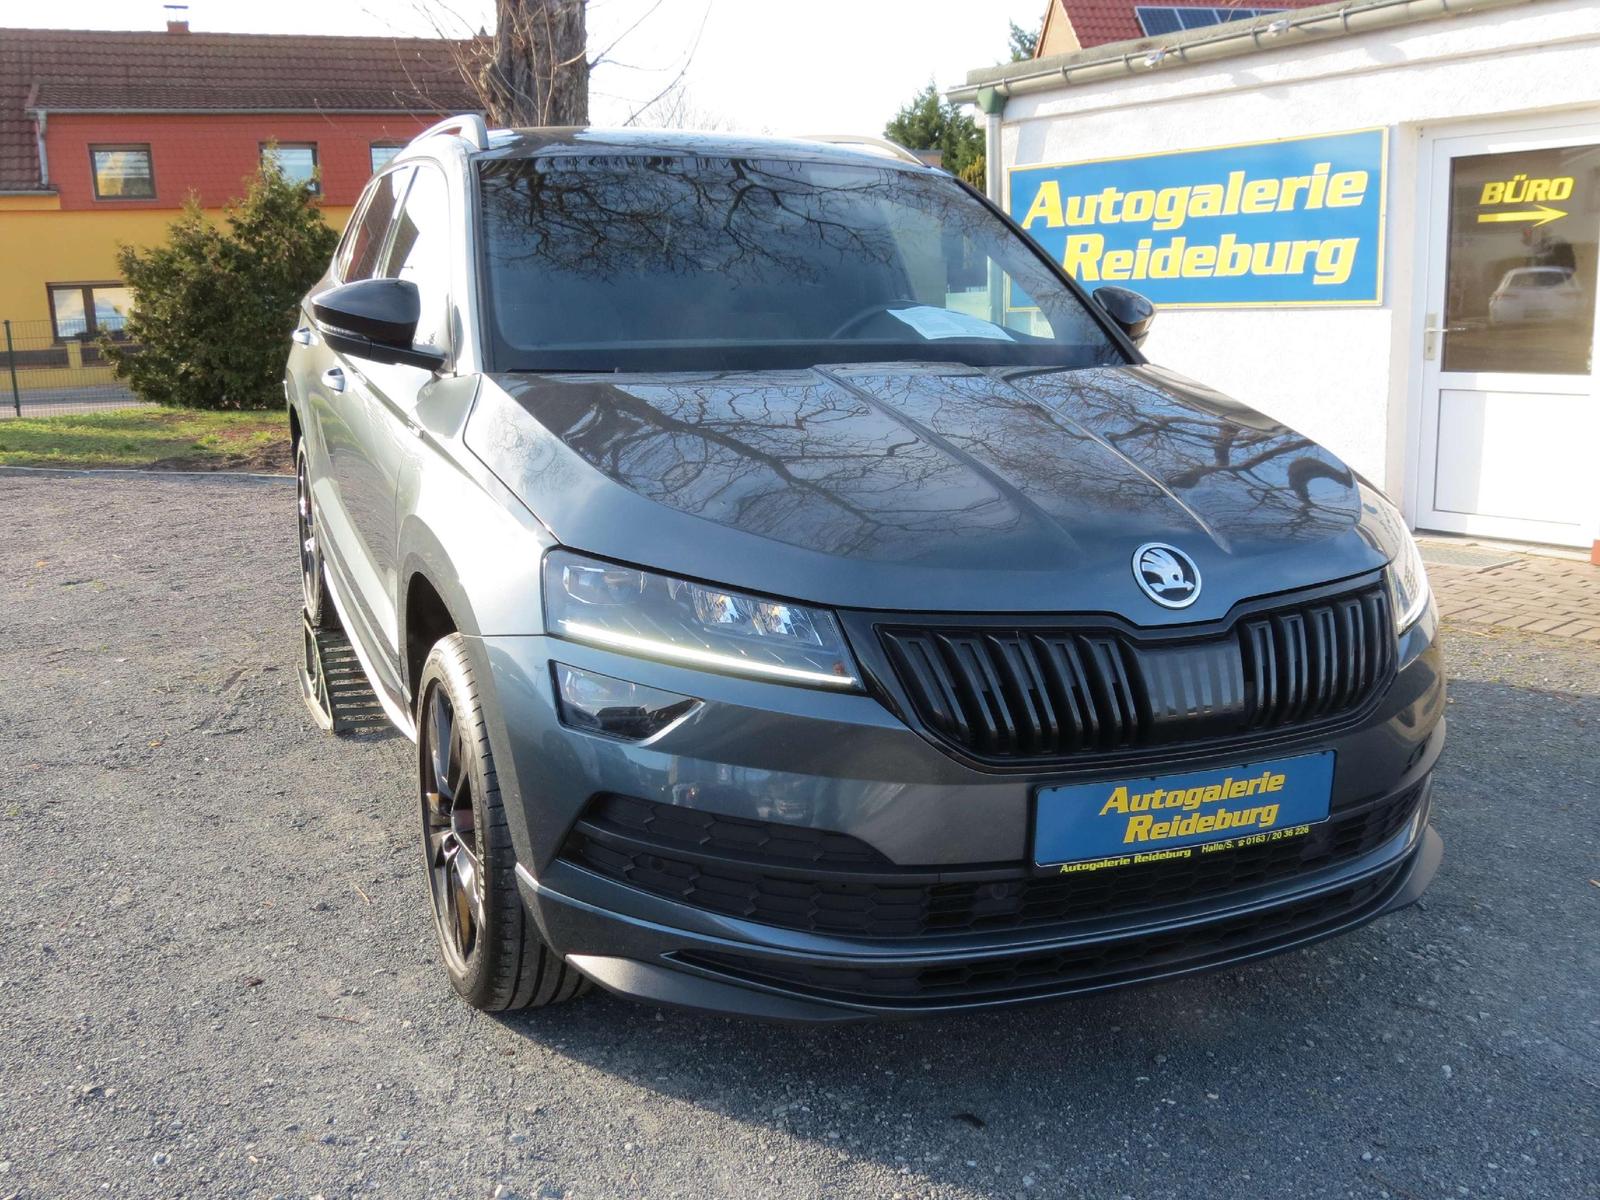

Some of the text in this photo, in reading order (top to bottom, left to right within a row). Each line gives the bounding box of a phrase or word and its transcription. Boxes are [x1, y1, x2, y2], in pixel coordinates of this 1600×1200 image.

[1022, 162, 1369, 231] Autogalerie
[1479, 174, 1574, 205] BÜRO
[1062, 233, 1359, 285] Reideburg
[1099, 771, 1286, 816] Autogalerie
[1123, 804, 1280, 843] Reideburg
[1060, 857, 1131, 873] Autogalerie
[1134, 849, 1192, 863] Reideburg
[1272, 831, 1282, 840] 20
